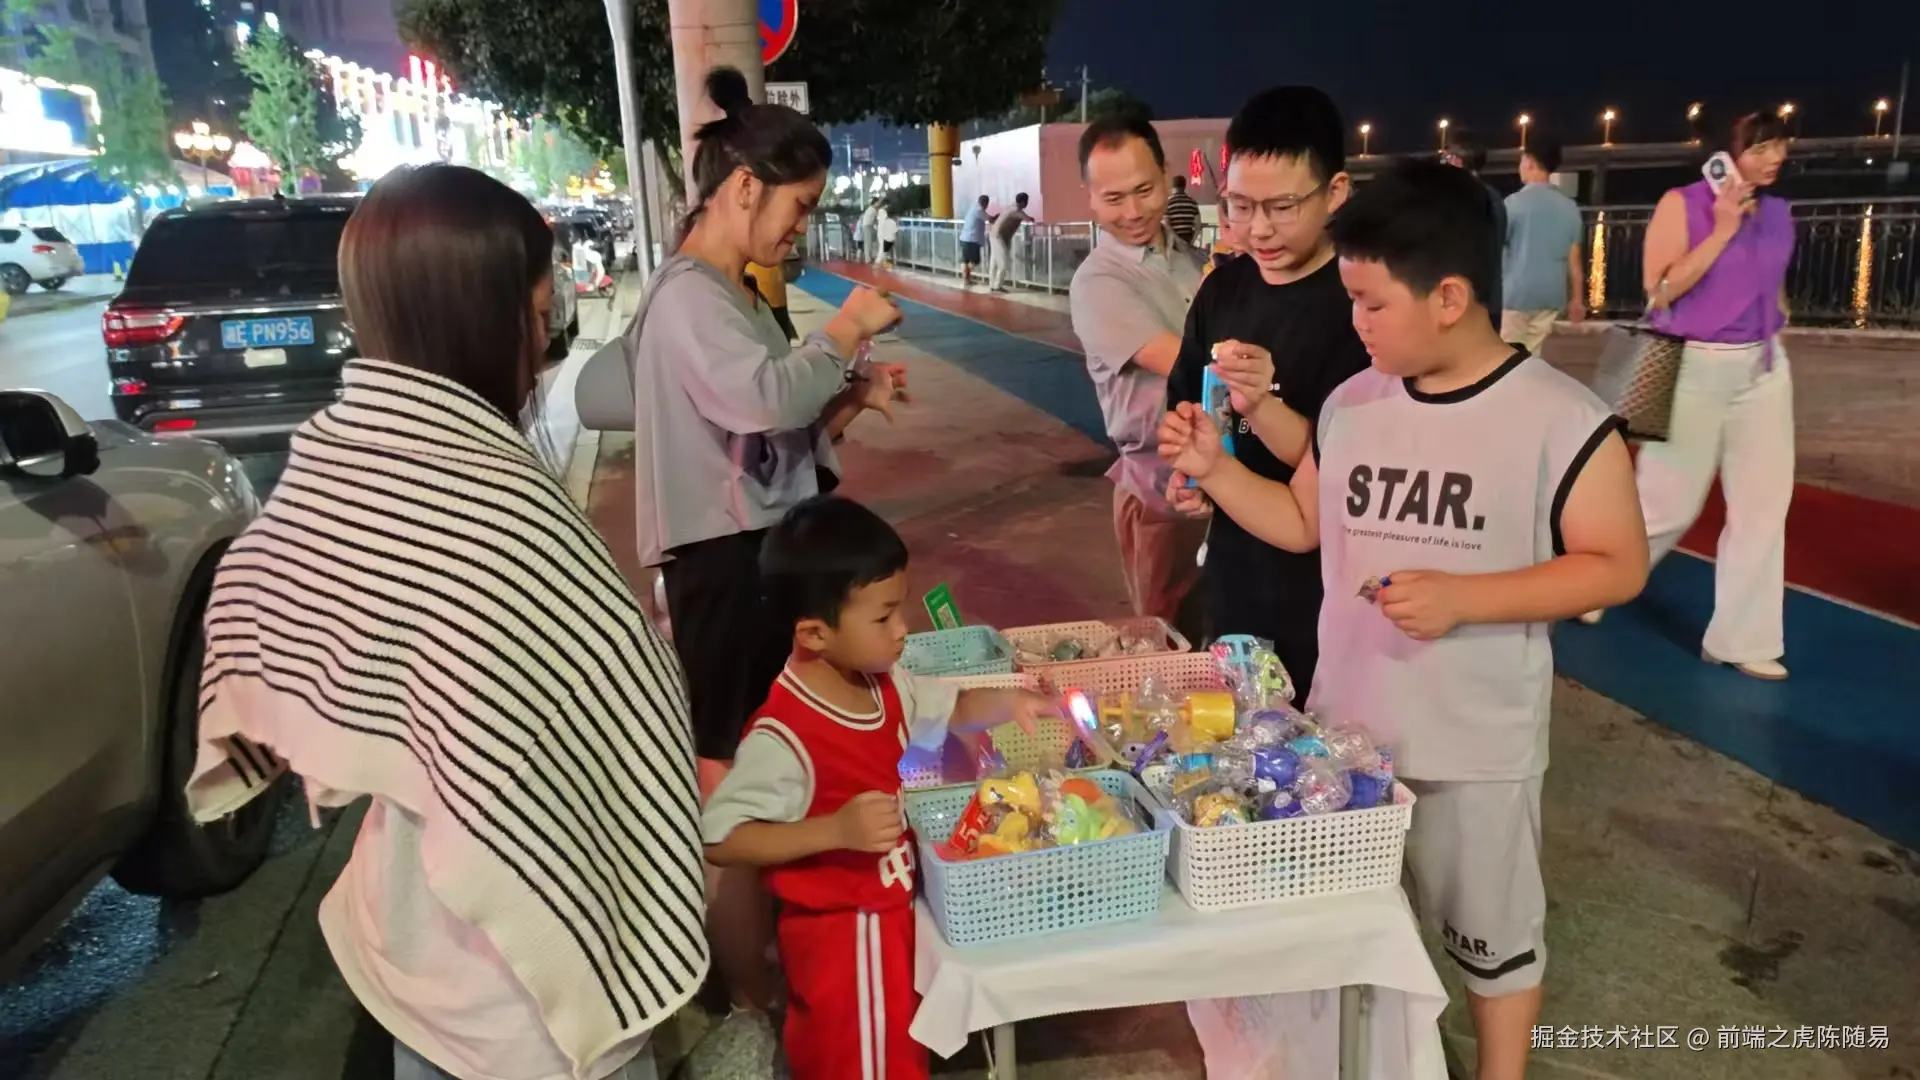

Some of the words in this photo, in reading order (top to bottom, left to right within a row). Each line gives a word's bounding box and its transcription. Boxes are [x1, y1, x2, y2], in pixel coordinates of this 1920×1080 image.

[1346, 464, 1485, 530] STAR.
[1352, 528, 1382, 538] greatest
[1383, 532, 1420, 543] pleasure
[1421, 536, 1433, 544] of
[1433, 537, 1450, 547] life
[1451, 538, 1460, 548] is
[1461, 540, 1482, 550] love
